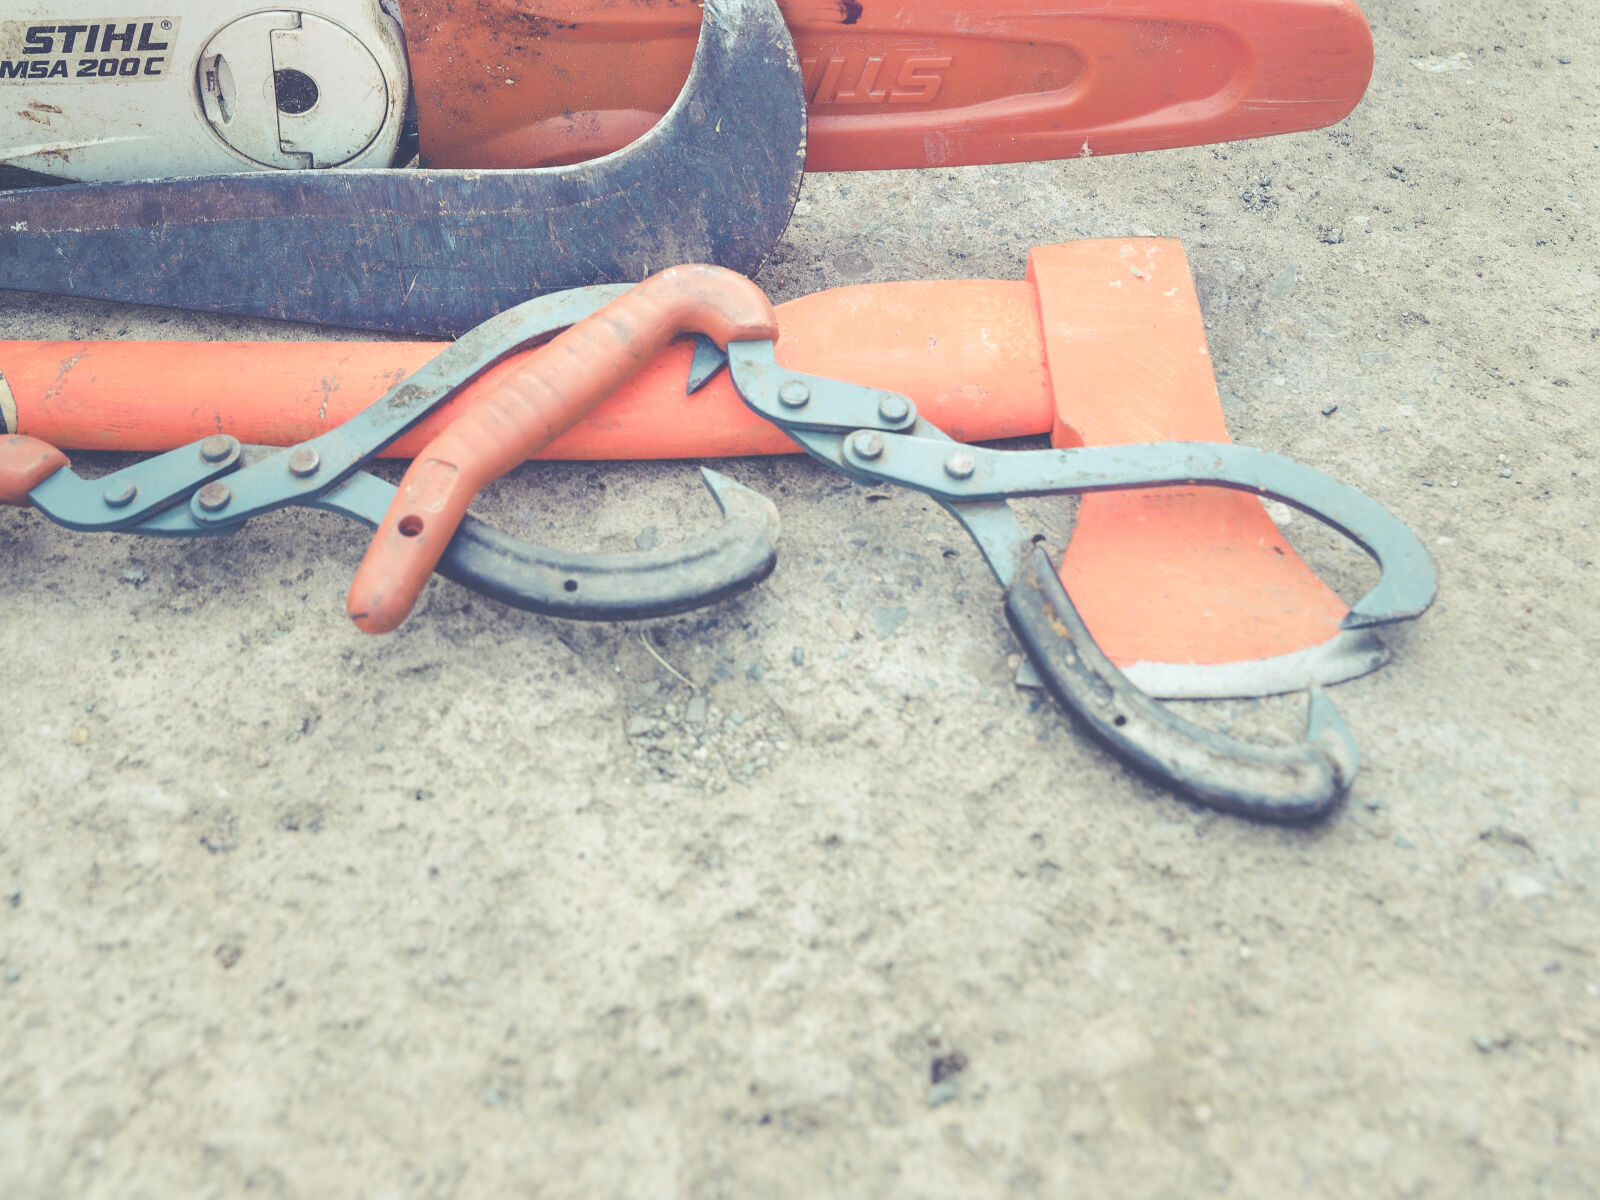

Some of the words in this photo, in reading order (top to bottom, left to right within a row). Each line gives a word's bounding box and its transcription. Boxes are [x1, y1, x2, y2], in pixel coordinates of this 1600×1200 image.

[0, 59, 68, 78] MSA
[76, 58, 140, 77] 200
[144, 57, 164, 75] C
[803, 56, 953, 104] STI
